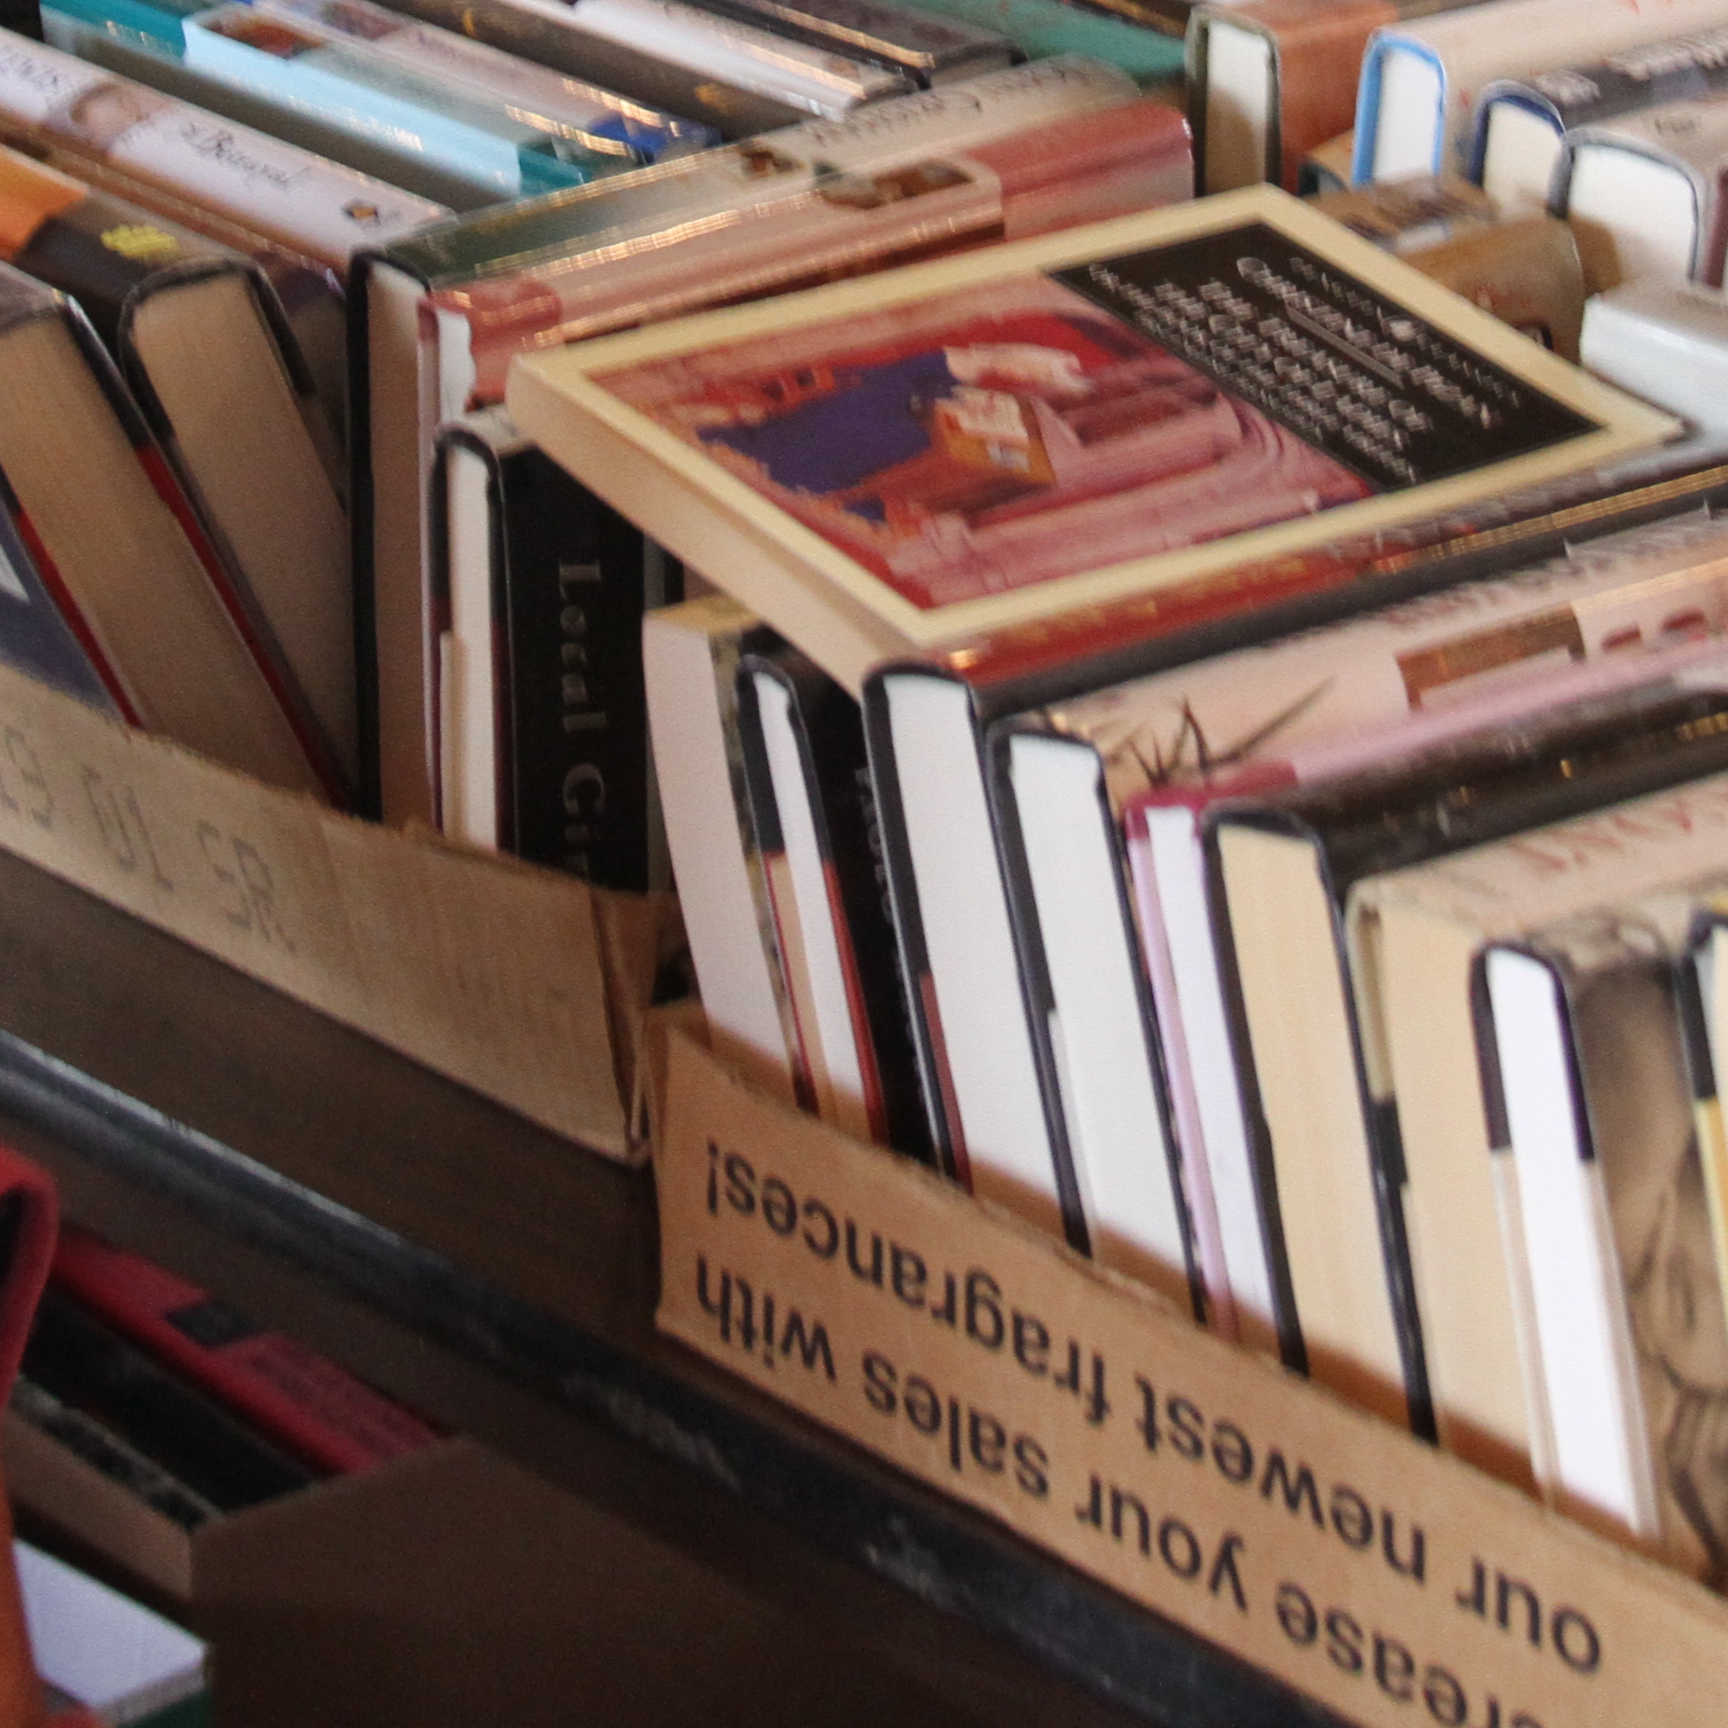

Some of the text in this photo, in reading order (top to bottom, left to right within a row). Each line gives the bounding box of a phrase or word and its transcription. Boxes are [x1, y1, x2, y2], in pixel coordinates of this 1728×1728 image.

[556, 558, 605, 735] Local
[696, 1253, 838, 1385] with
[704, 1140, 1603, 1676] our newest fragrances!
[861, 1346, 1050, 1504] sales
[1073, 1471, 1248, 1617] your
